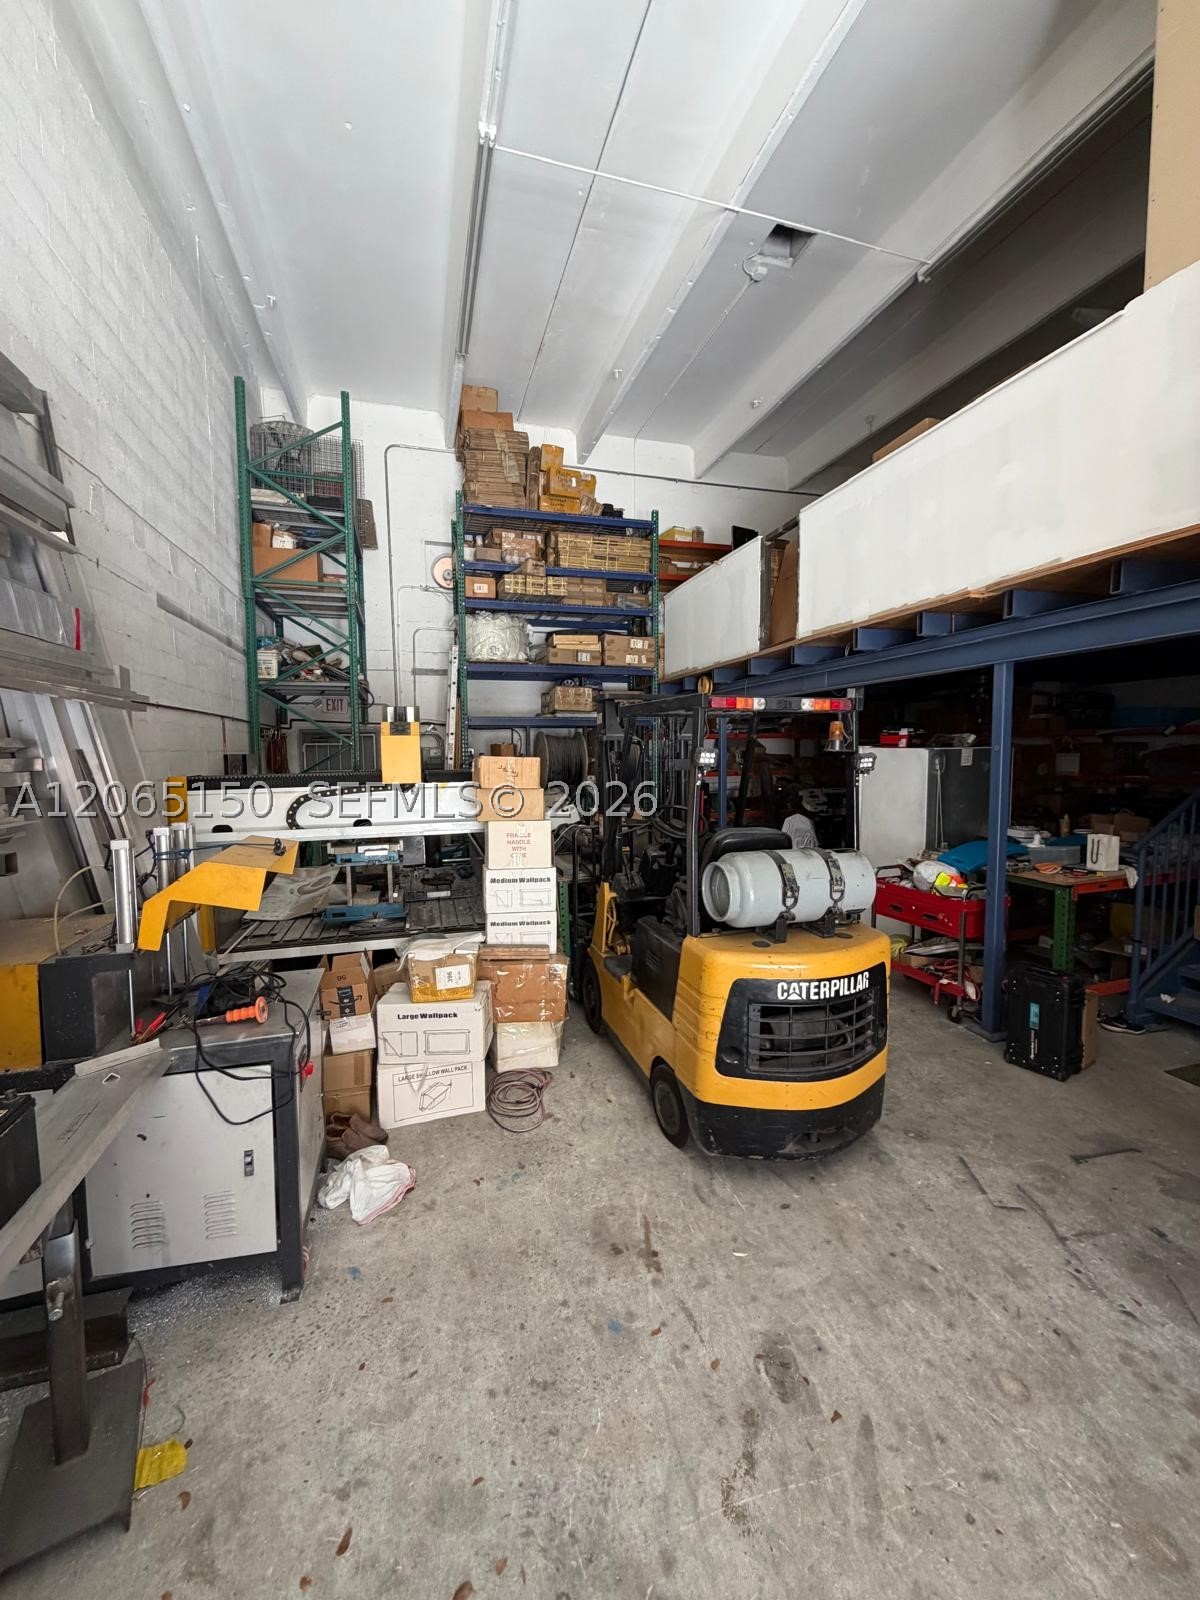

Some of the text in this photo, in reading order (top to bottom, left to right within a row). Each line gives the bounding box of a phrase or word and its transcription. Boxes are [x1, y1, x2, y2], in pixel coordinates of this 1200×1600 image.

[326, 698, 344, 712] EXIT
[777, 971, 870, 1000] CATERPILLAR
[398, 1073, 415, 1082] LARGE
[440, 1067, 454, 1075] WALL
[454, 1064, 468, 1072] PACK
